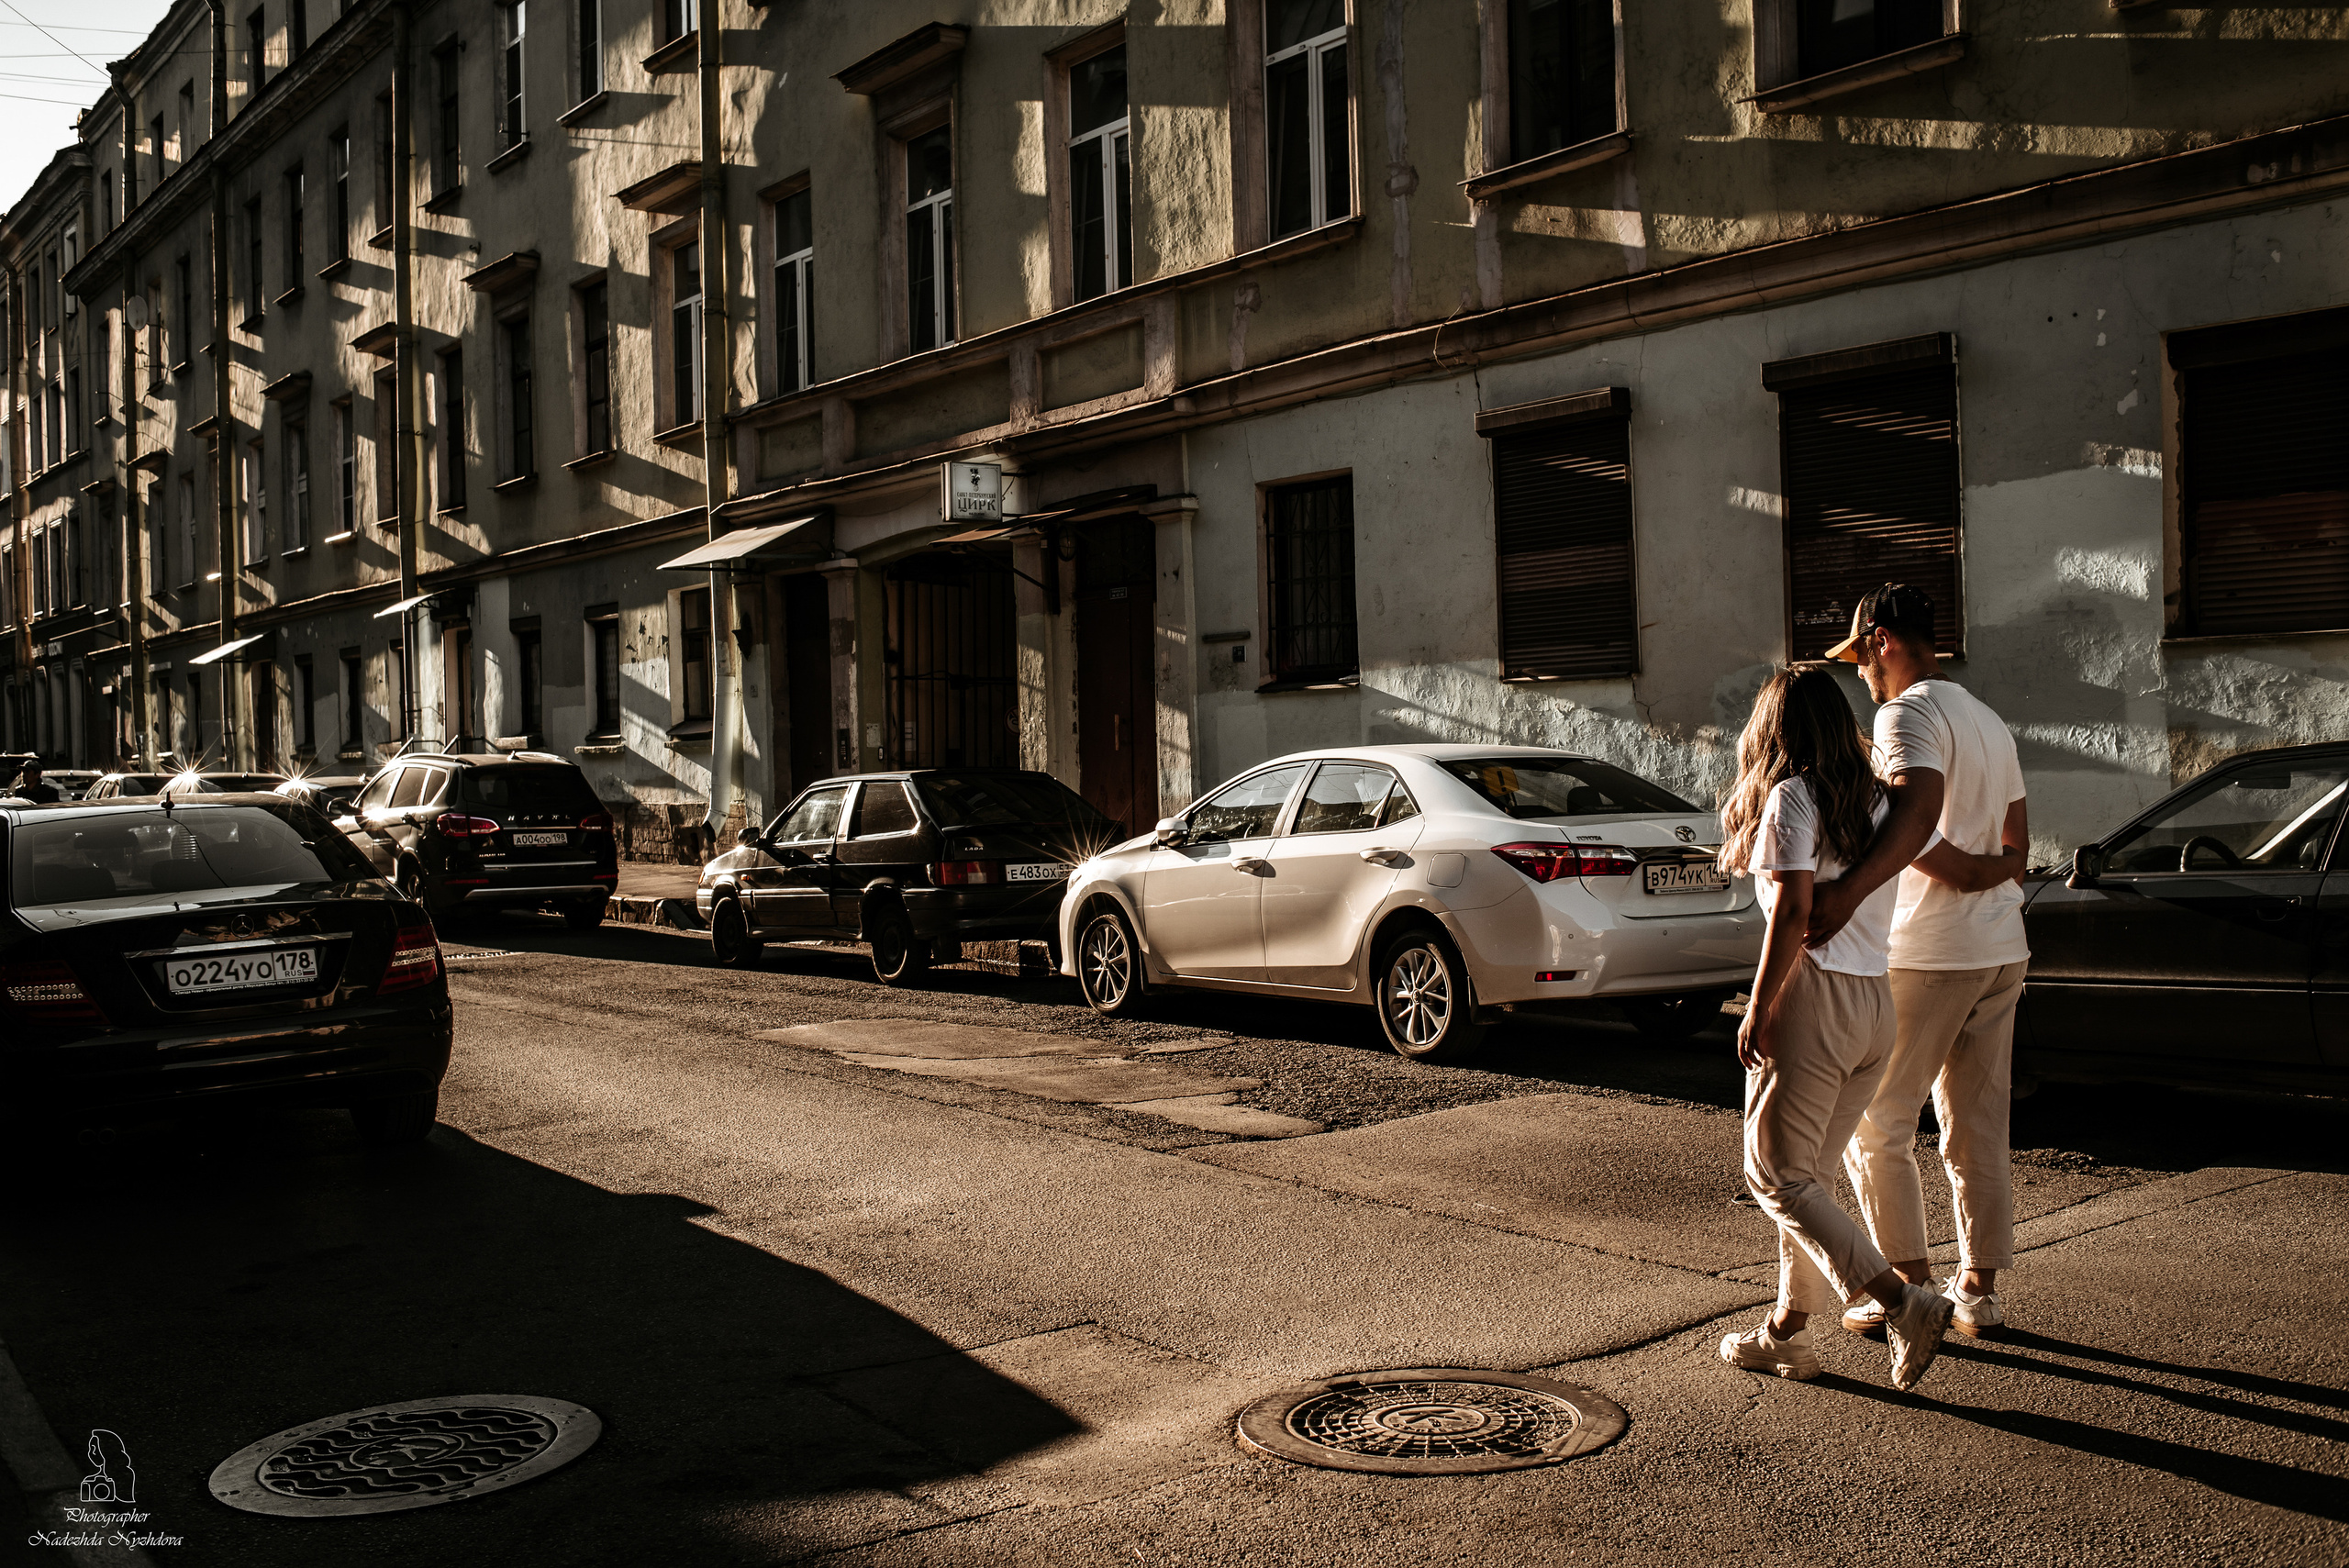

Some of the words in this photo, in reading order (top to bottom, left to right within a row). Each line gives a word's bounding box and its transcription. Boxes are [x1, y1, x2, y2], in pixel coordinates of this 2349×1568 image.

[958, 498, 996, 512] ЦИРК
[275, 951, 311, 972] 178
[284, 969, 303, 978] RUS
